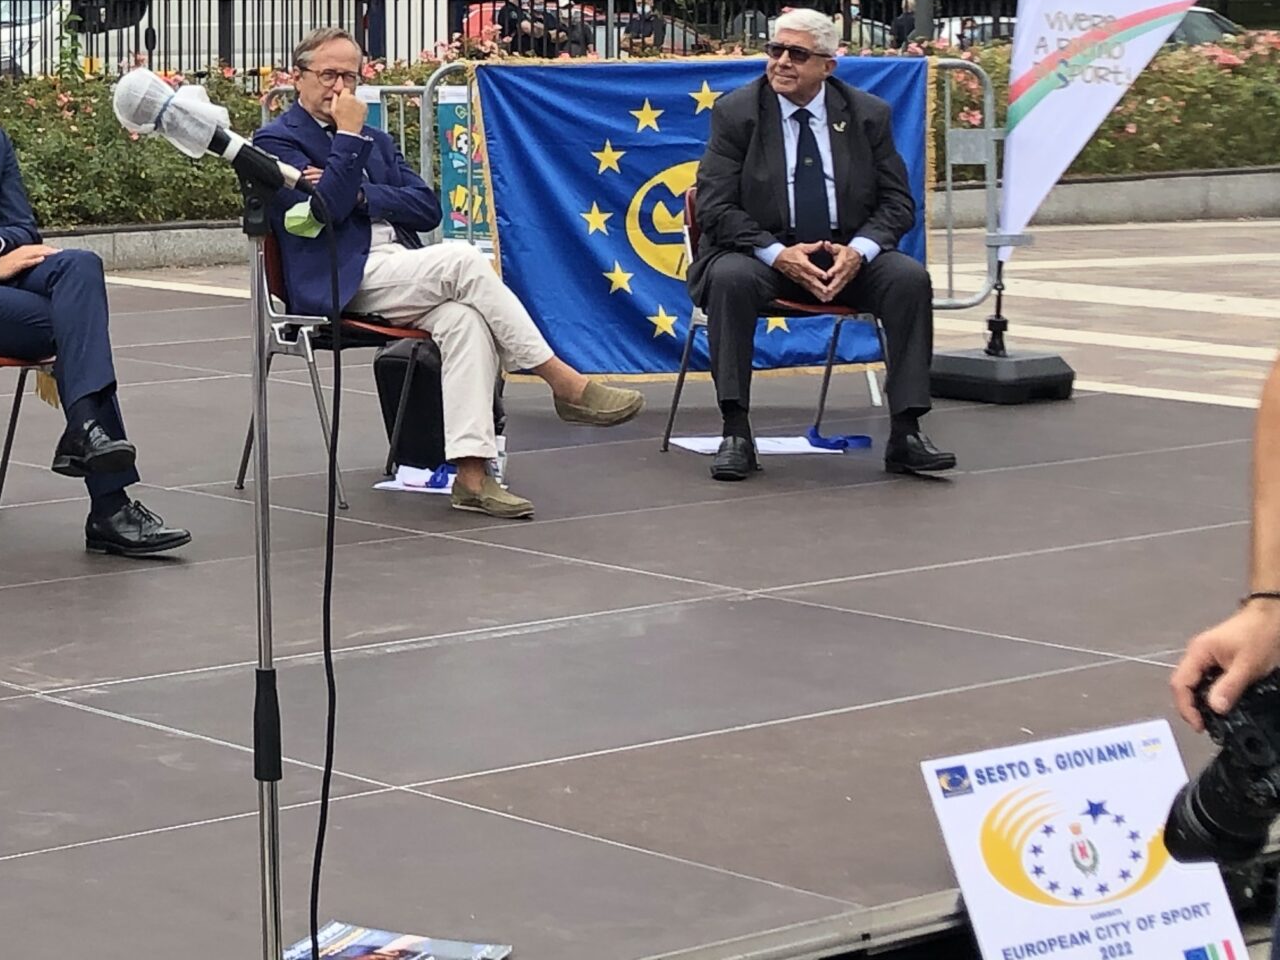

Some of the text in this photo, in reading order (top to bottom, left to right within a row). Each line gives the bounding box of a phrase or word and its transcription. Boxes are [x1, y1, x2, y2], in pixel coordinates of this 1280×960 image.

[974, 741, 1136, 786] SESTO S. GIOVANNI
[1001, 929, 1091, 960] EUROPEAN
[1095, 919, 1131, 942] CITY
[1136, 914, 1156, 932] OF
[1161, 902, 1212, 926] SPORT
[1100, 941, 1133, 959] 2022
